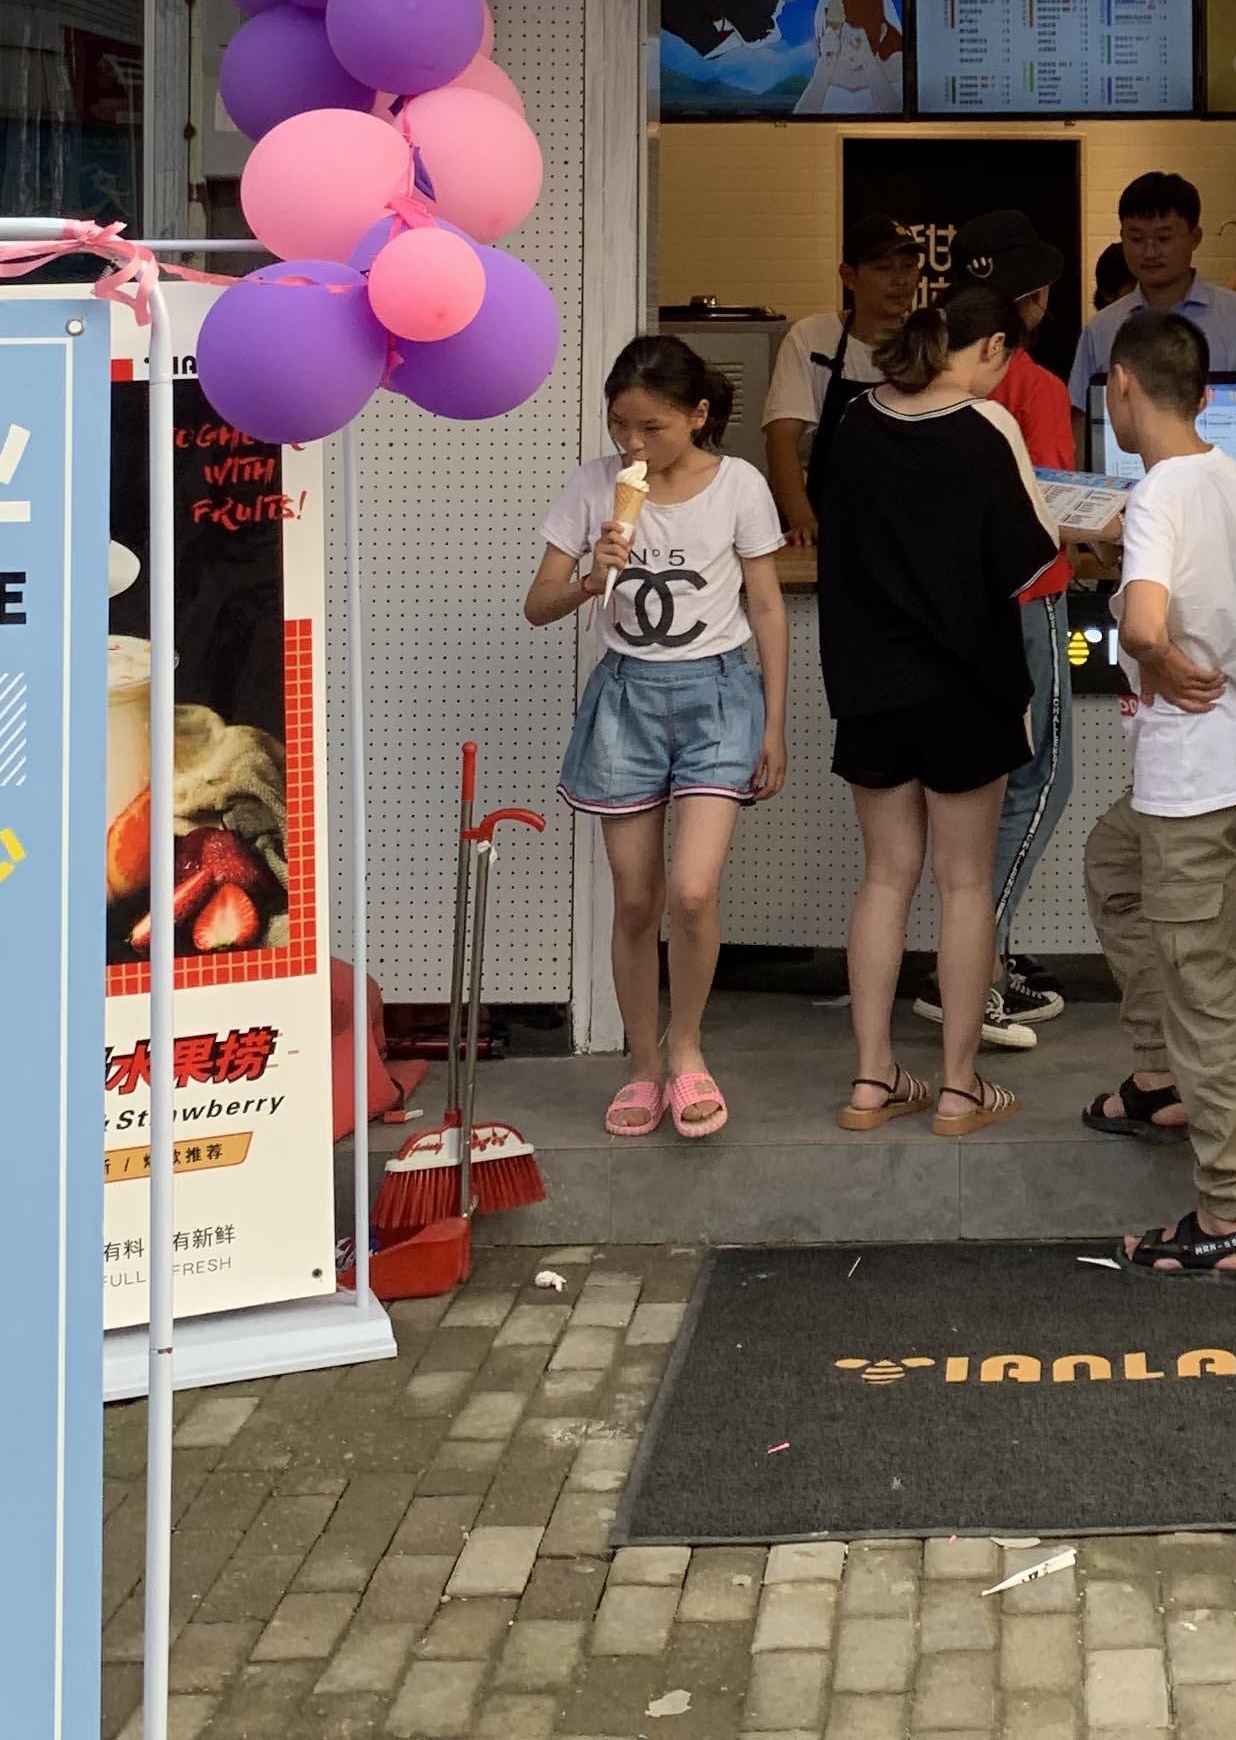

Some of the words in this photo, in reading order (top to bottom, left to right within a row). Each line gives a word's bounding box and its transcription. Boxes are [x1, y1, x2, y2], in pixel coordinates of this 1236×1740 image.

[204, 454, 276, 486] WITH
[192, 489, 308, 532] FRUITS!
[104, 1026, 278, 1096] 水果捞
